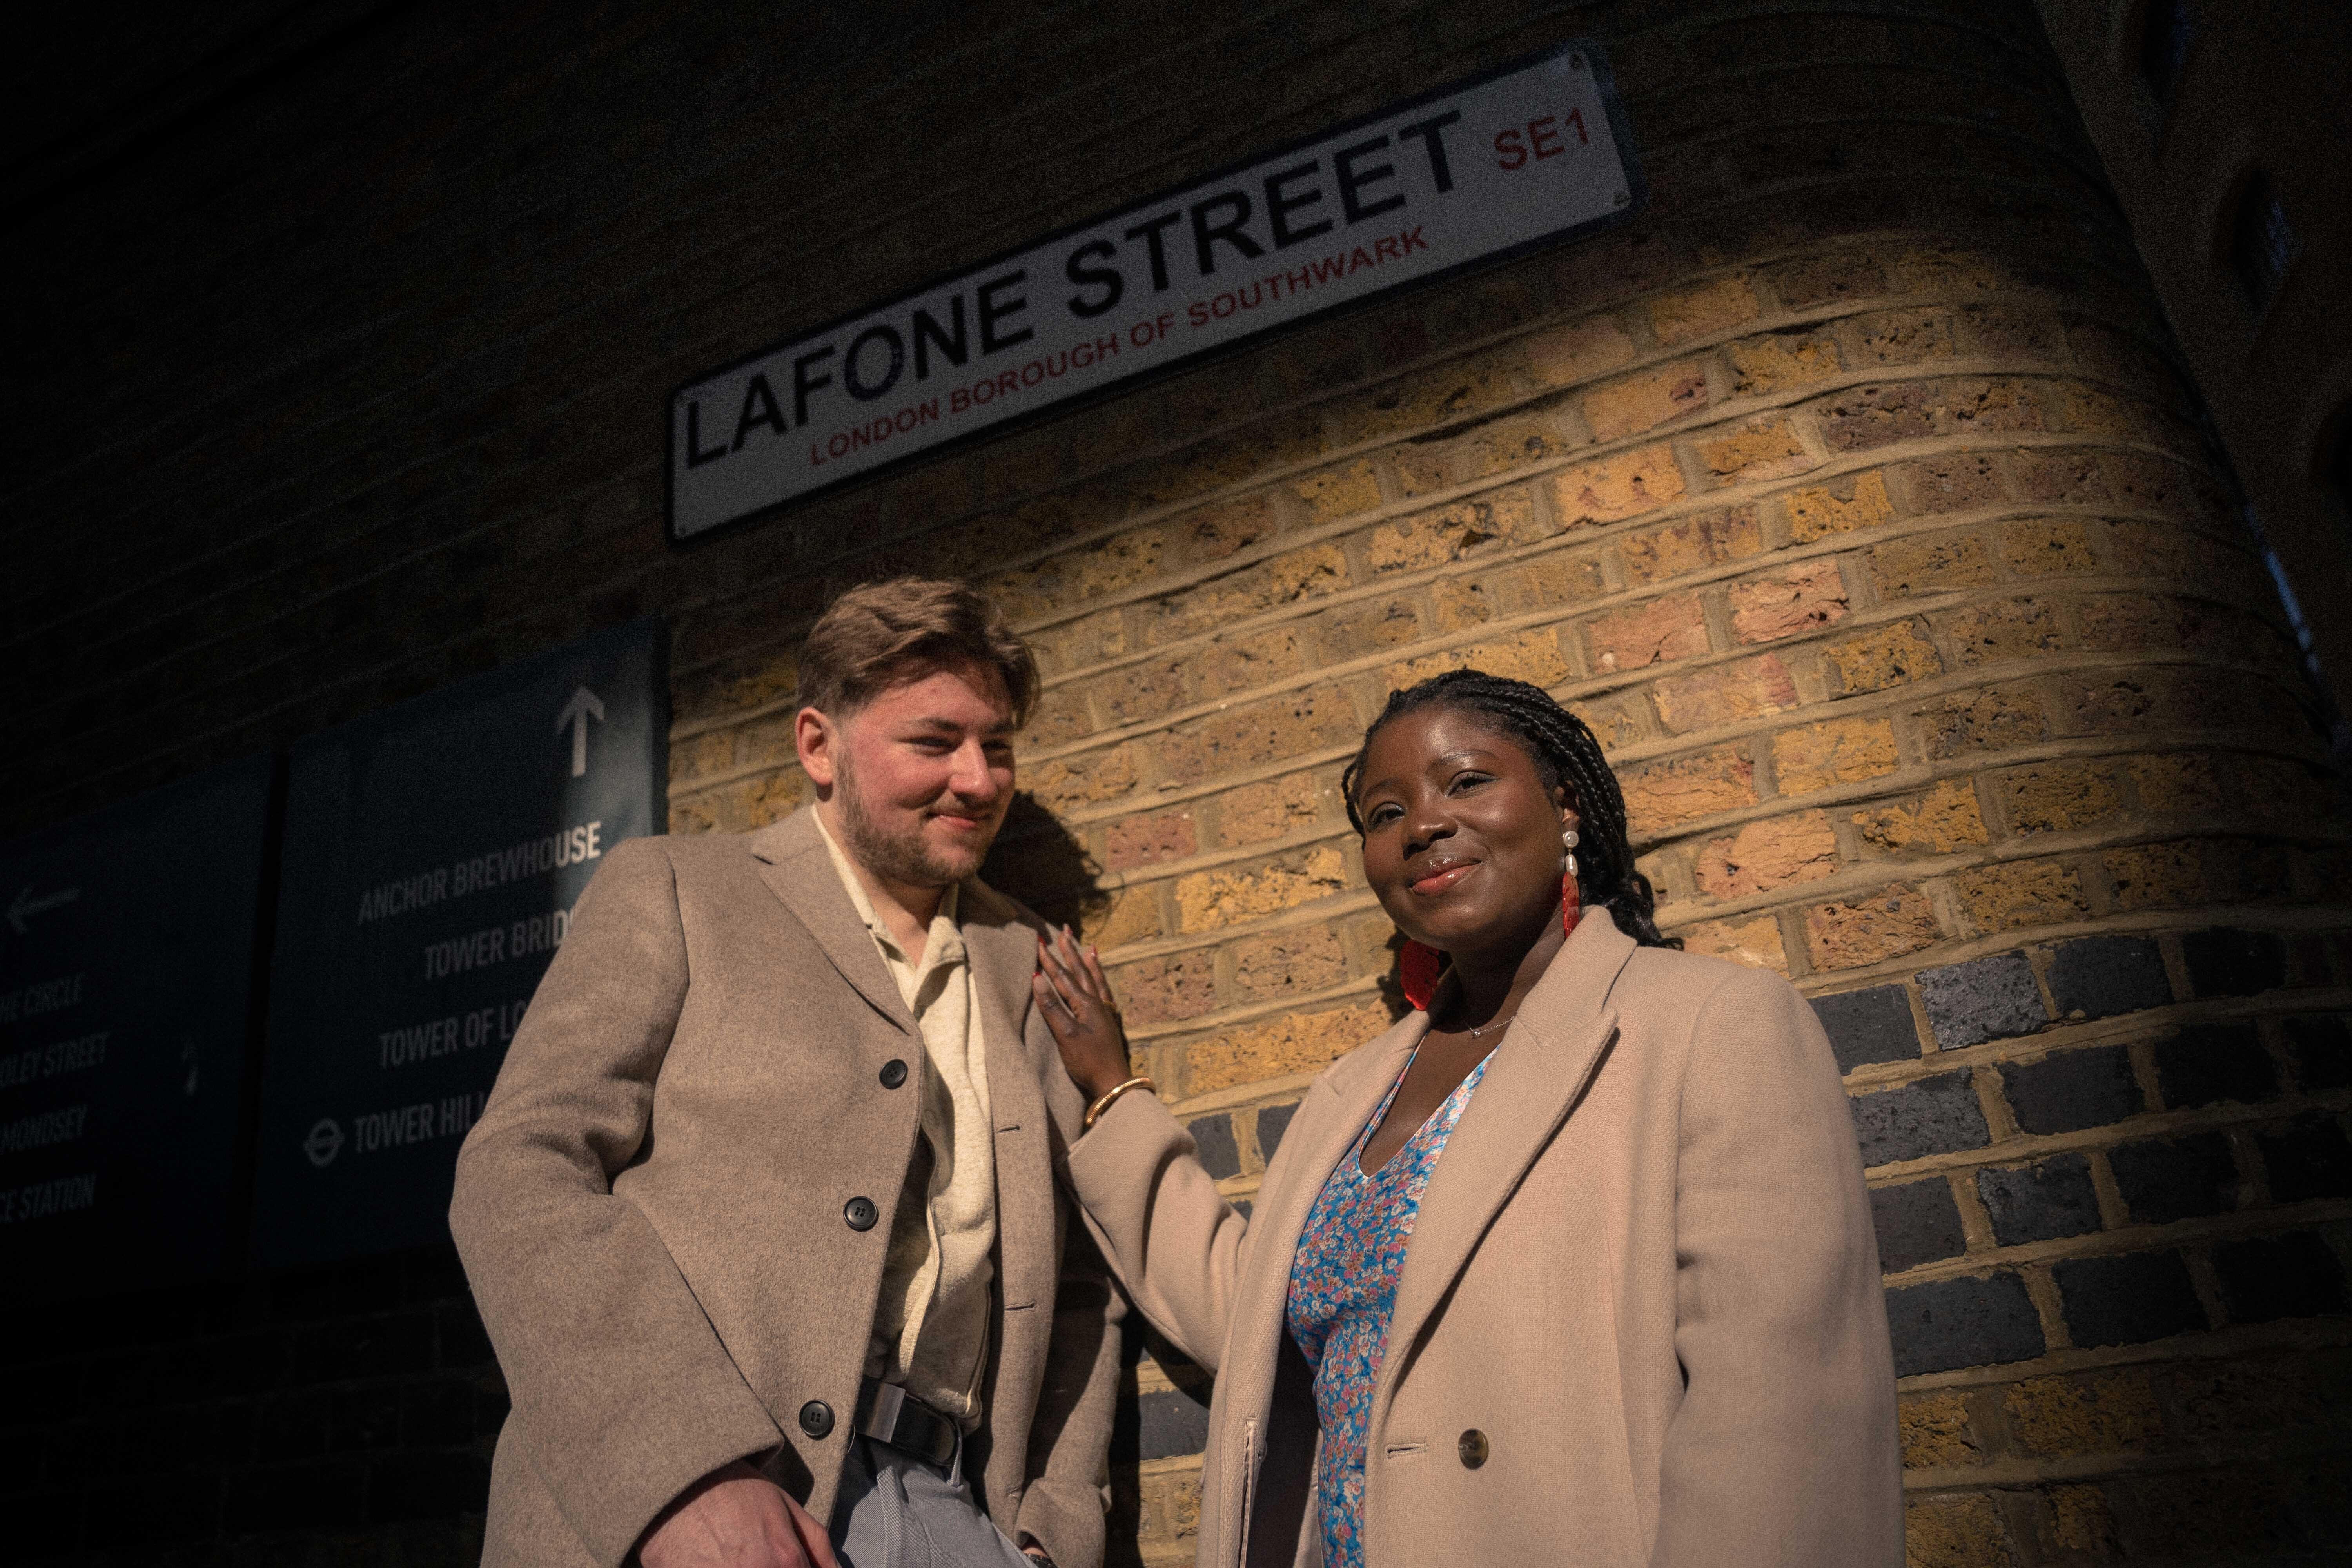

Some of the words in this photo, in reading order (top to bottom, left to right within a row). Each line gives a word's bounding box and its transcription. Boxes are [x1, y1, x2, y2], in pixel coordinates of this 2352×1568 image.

[688, 270, 1034, 469] LAFONE
[1065, 110, 1461, 318] STREET
[1494, 108, 1590, 171] SE1
[810, 397, 939, 466] LONDON
[949, 333, 1120, 414] BOROUGH
[1129, 312, 1175, 347] OF
[1188, 227, 1429, 328] SOUTHWARK
[357, 867, 447, 926] ANCHOR
[452, 820, 602, 897] BREWHOUSE
[424, 927, 505, 980] TOWER
[511, 909, 575, 958] BRID
[23, 971, 86, 1018] CIRCLE
[43, 1031, 110, 1077] STREET
[379, 1016, 459, 1070] TOWER
[464, 1007, 495, 1049] OF
[352, 1102, 434, 1154] TOWER
[19, 1173, 98, 1220] STATION
